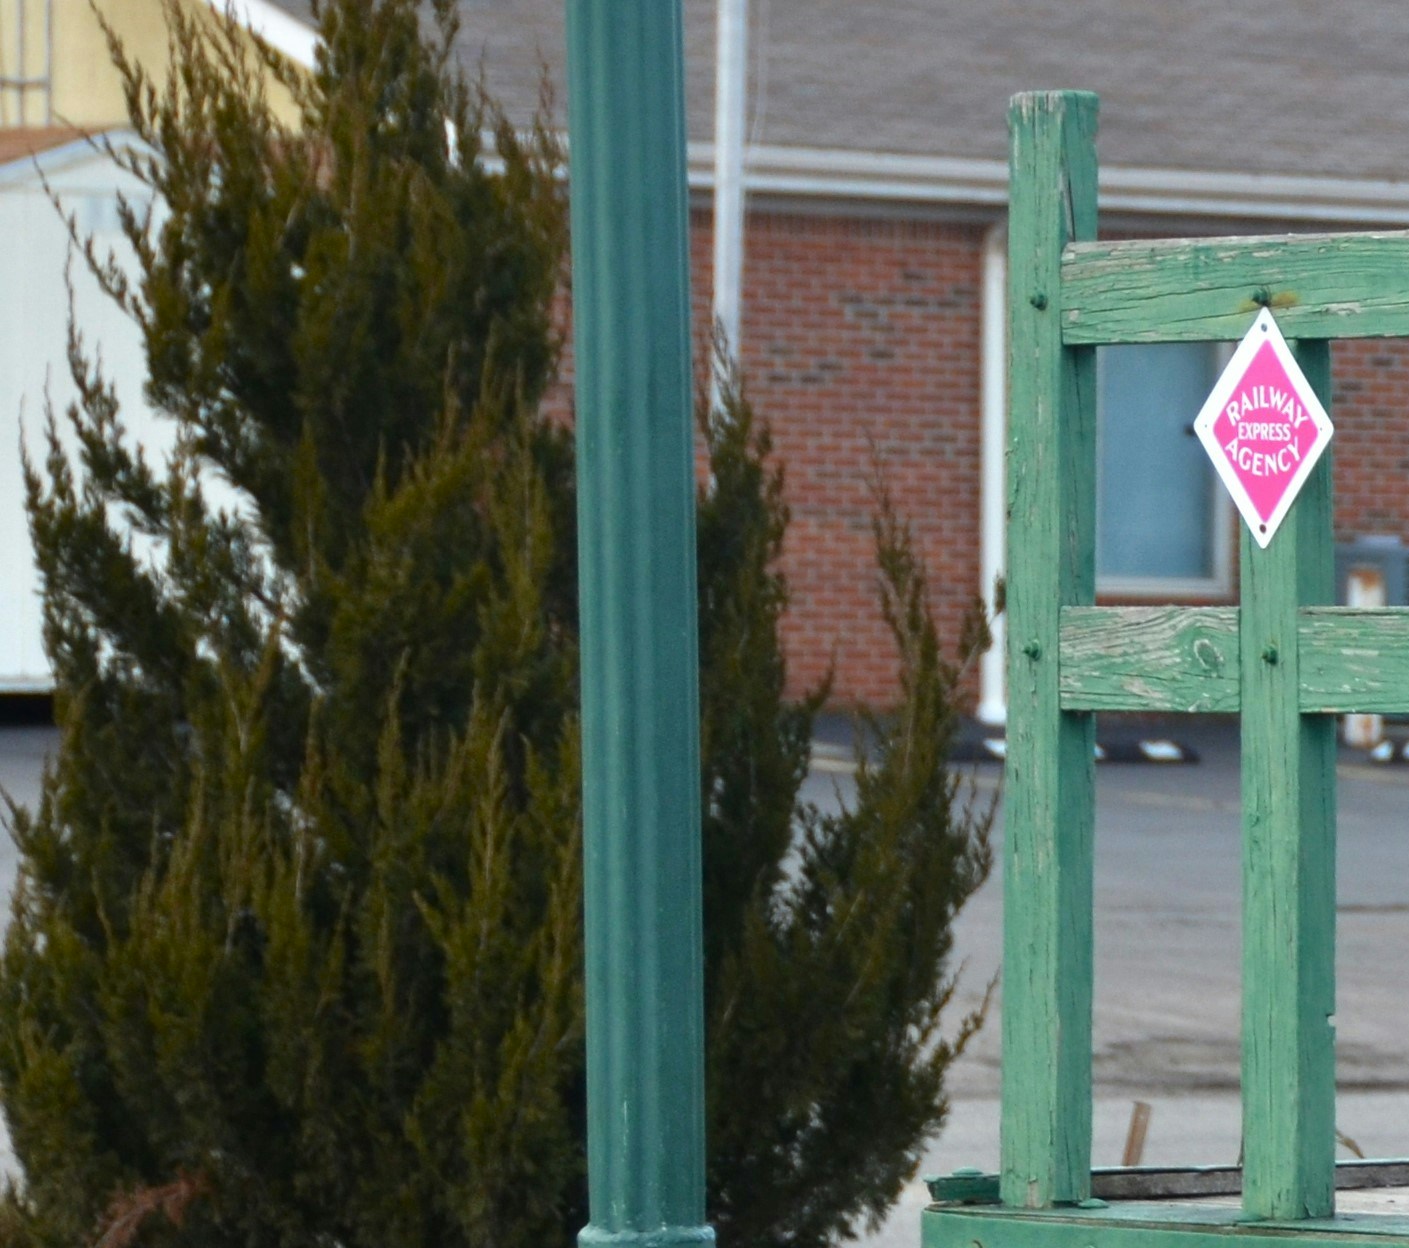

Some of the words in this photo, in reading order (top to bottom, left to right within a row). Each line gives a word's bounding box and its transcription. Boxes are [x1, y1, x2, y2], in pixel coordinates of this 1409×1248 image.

[1226, 385, 1308, 428] RAILWAY
[1238, 422, 1291, 441] EXPRESS
[1225, 437, 1301, 476] AGENCY
